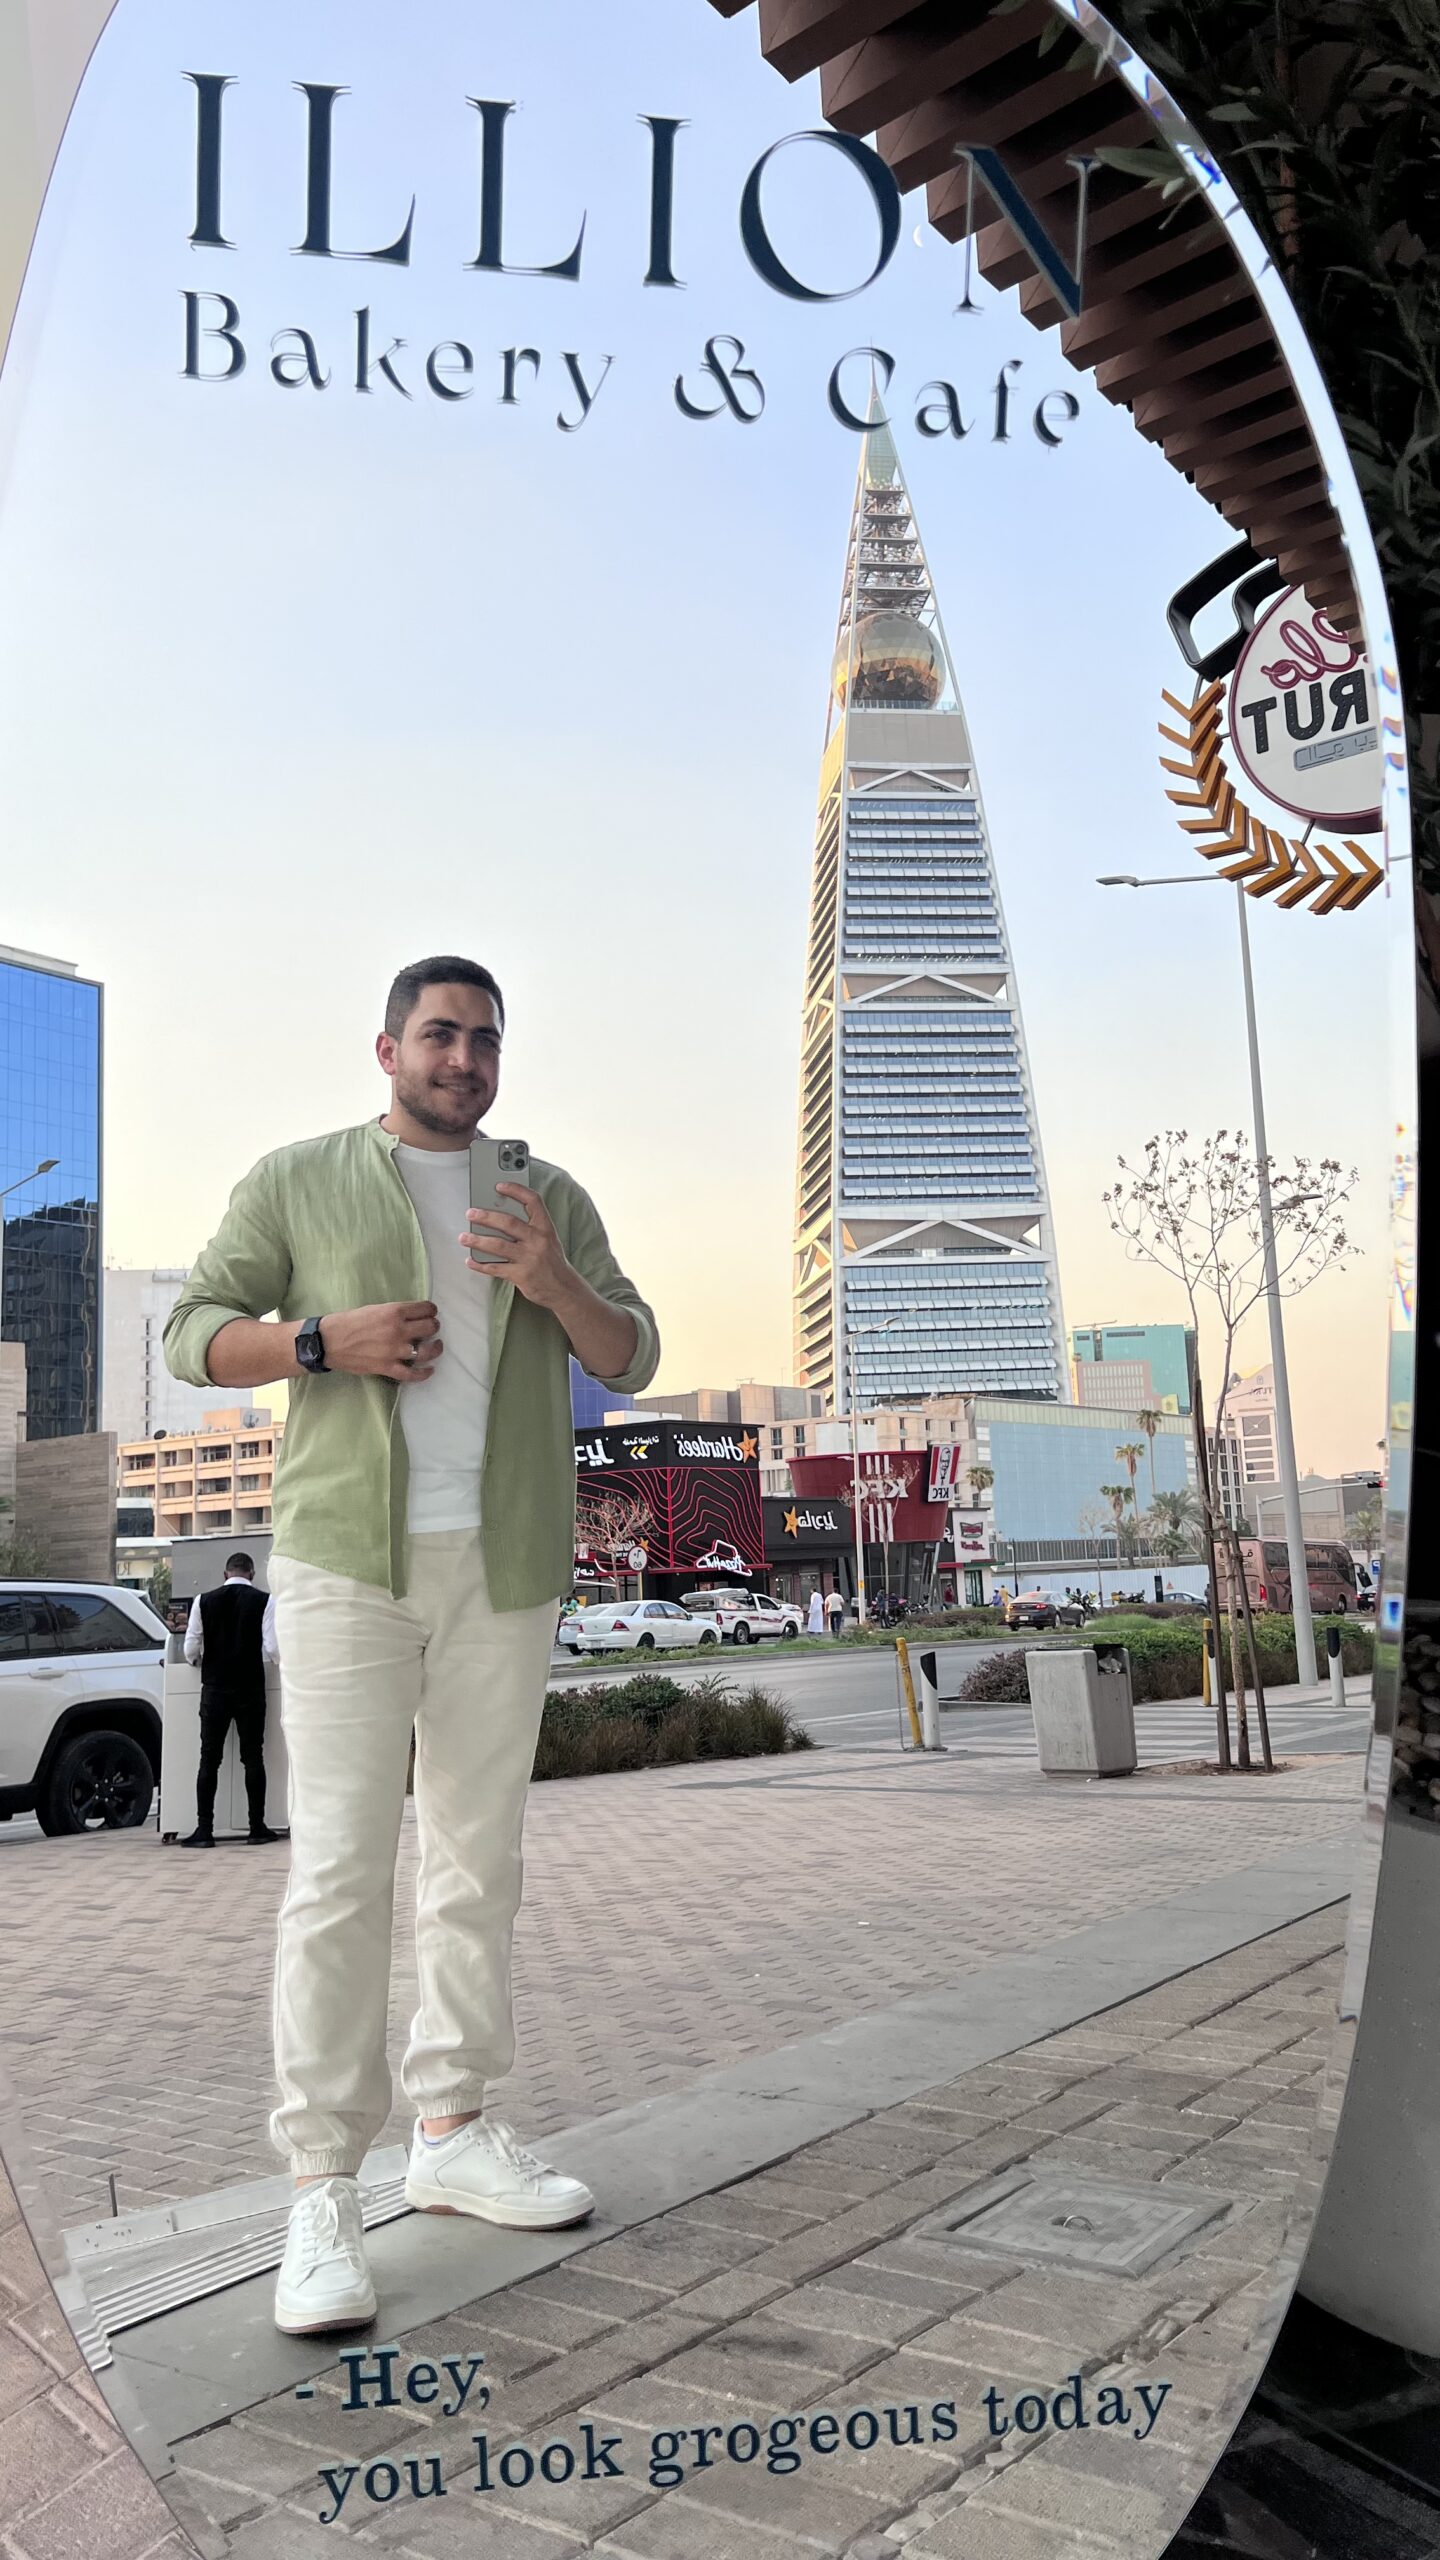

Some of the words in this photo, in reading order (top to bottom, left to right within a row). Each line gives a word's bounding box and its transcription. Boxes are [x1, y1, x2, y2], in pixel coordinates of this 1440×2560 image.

[180, 70, 1099, 320] ILLION
[179, 288, 616, 432] Bakery
[673, 333, 768, 425] &
[827, 345, 1081, 447] Cafe
[318, 2446, 448, 2525] you
[472, 2424, 625, 2494] look
[648, 2397, 960, 2488] grogeous
[981, 2371, 1174, 2441] today
[339, 2345, 491, 2416] Hey,
